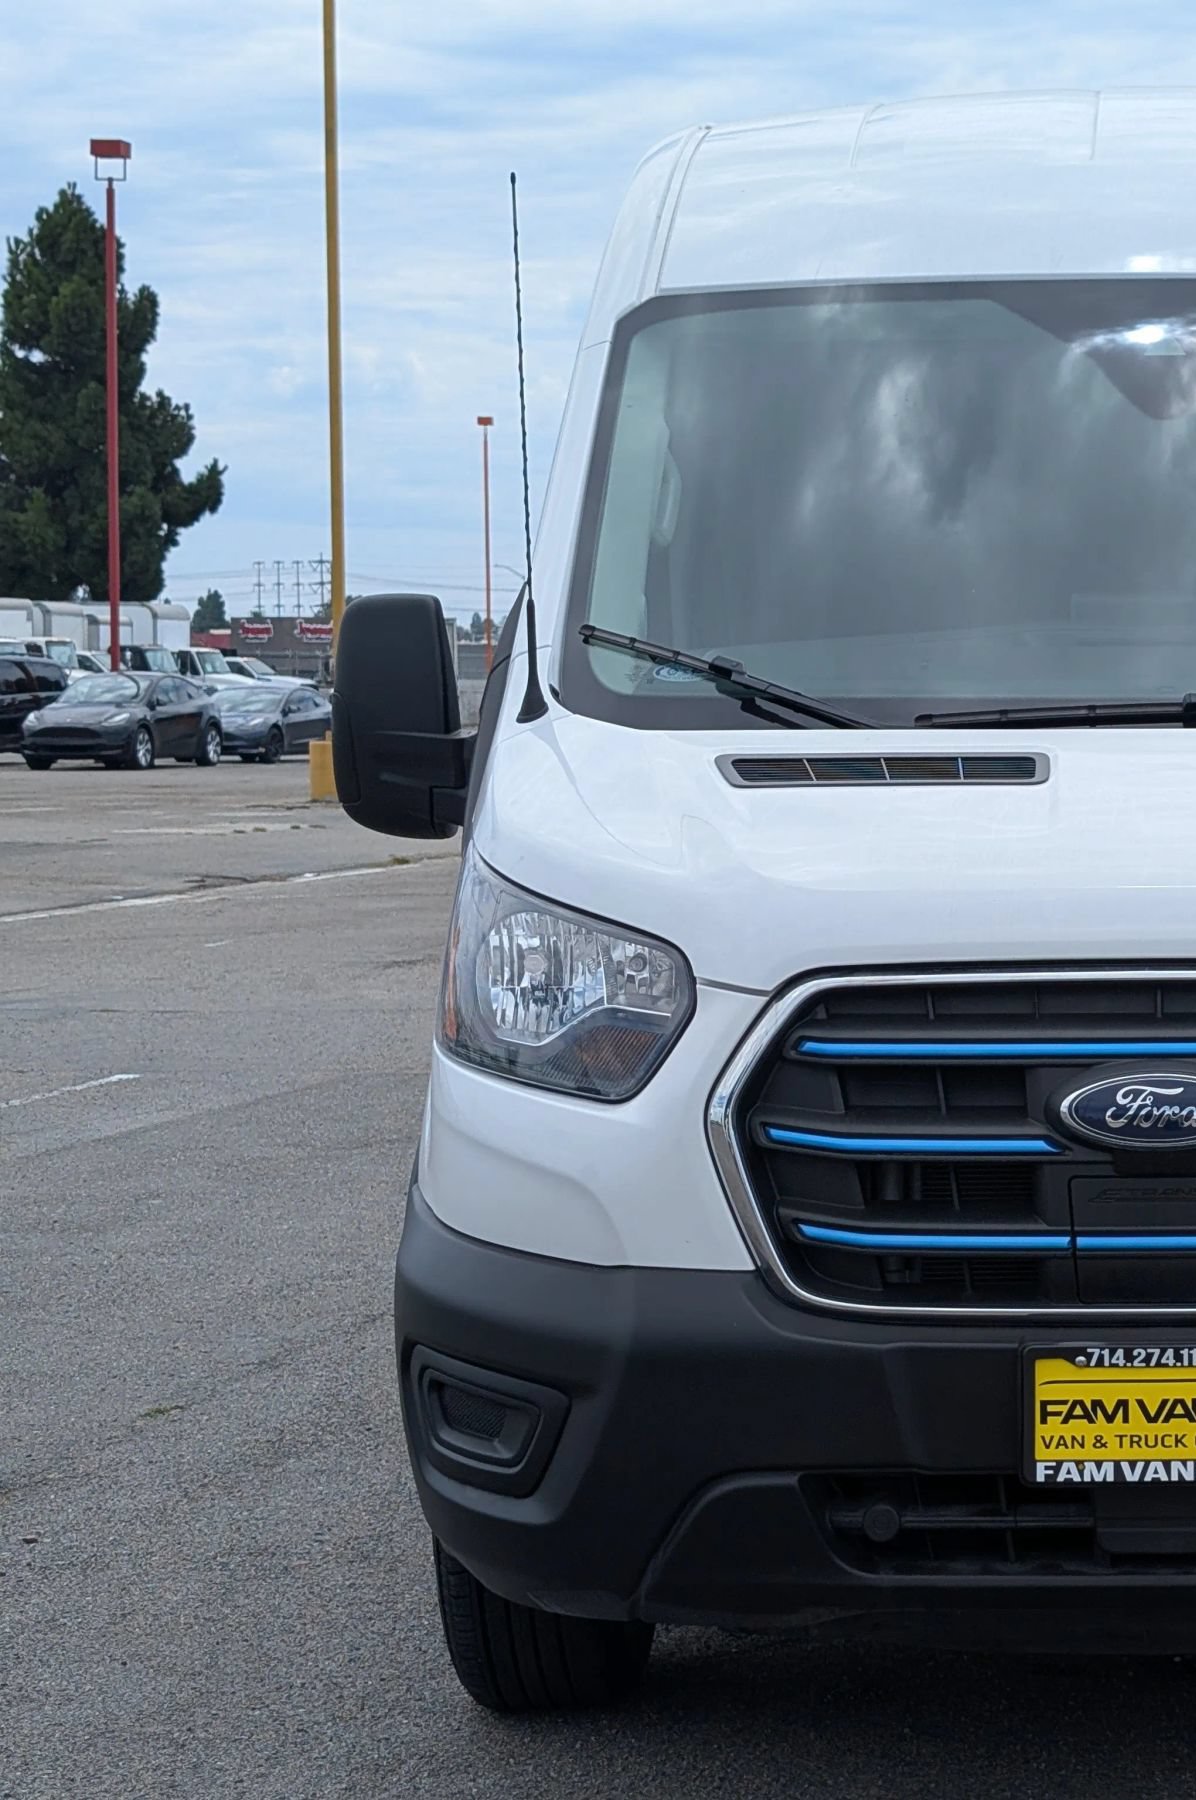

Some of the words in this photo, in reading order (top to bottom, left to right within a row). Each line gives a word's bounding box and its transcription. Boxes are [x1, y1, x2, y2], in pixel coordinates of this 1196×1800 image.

[1040, 1434, 1085, 1450] VAN
[1092, 1434, 1108, 1449] &
[1114, 1433, 1188, 1449] TRUCK
